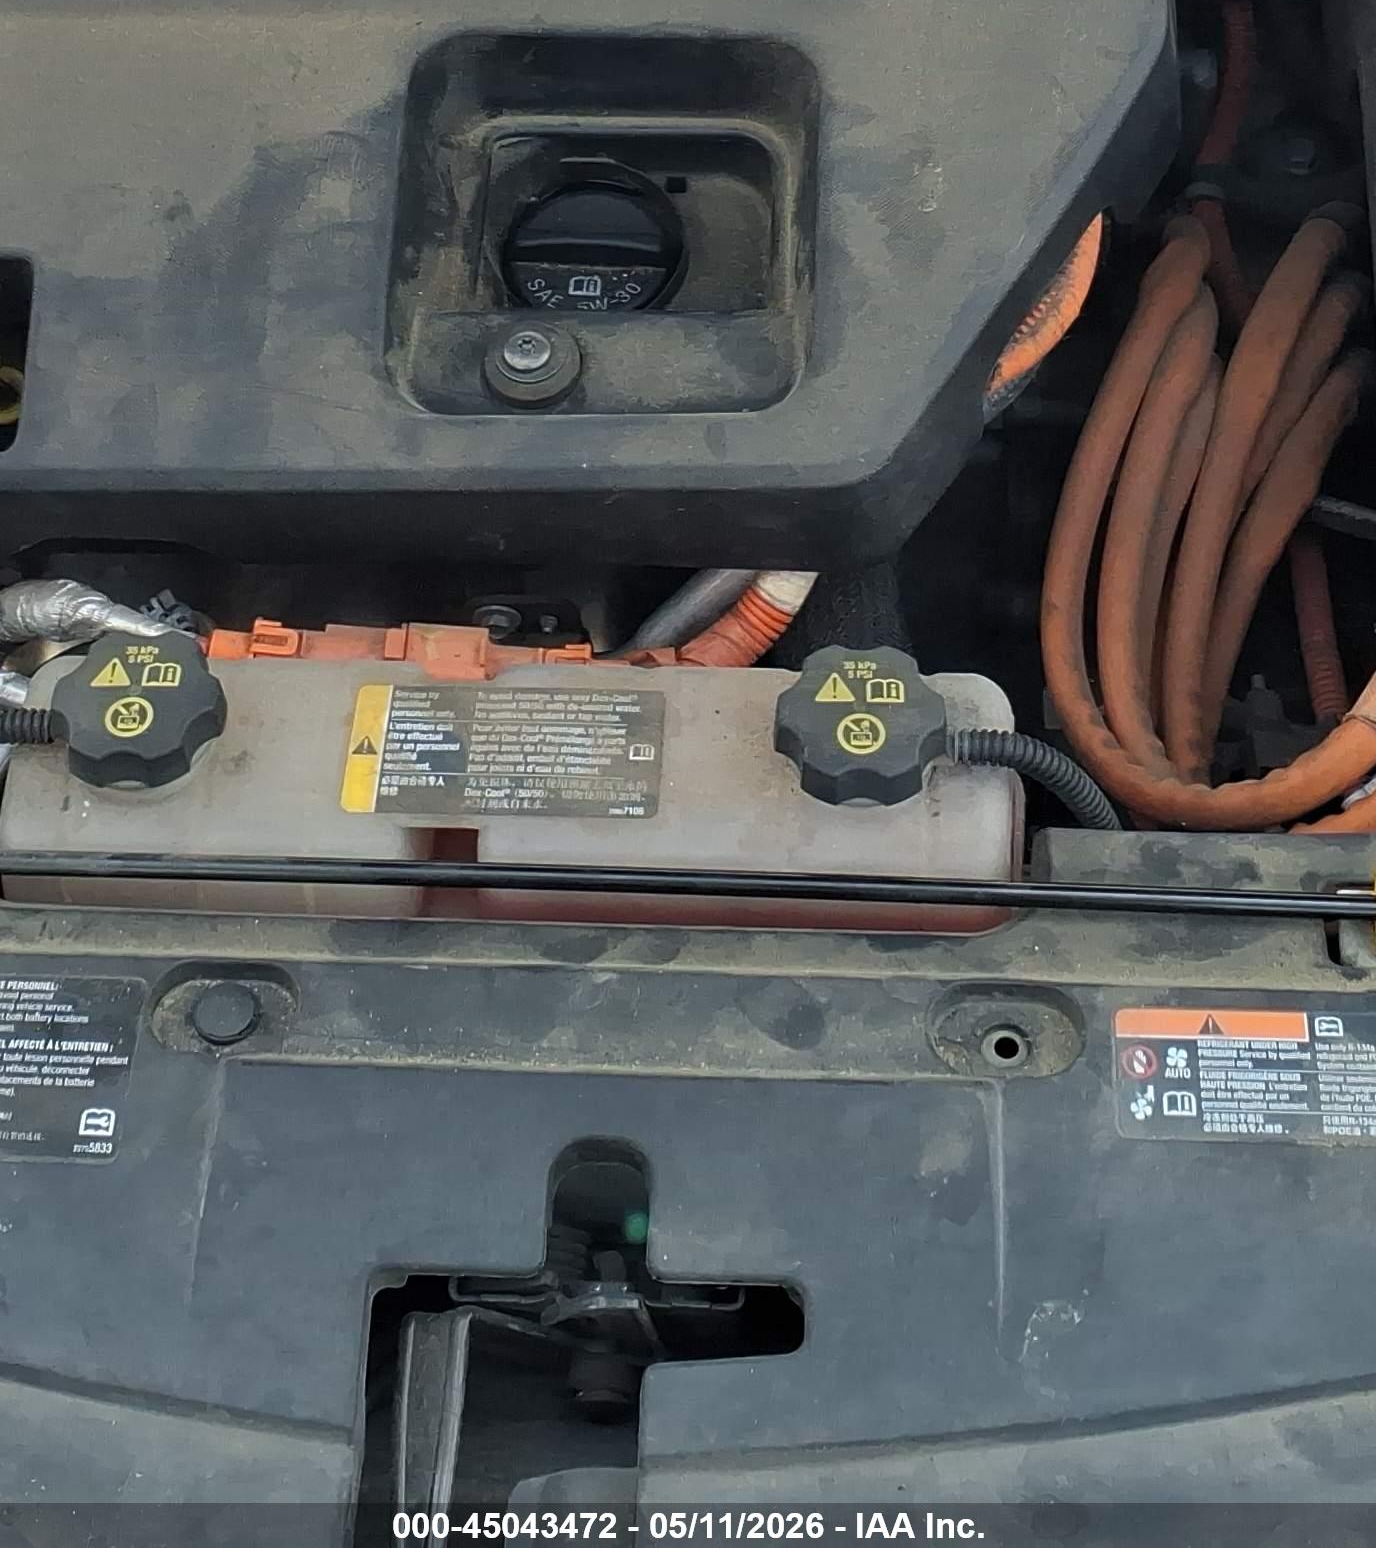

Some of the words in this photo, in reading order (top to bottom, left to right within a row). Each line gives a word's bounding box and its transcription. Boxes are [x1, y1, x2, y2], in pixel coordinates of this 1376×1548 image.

[528, 279, 564, 308] SAE
[141, 646, 159, 655] kPa
[137, 655, 154, 663] PSI
[843, 661, 855, 669] 35
[858, 661, 877, 670] kPa
[848, 670, 854, 678] 5
[857, 670, 873, 679] PSI
[8, 1038, 44, 1049] AFFECTÉ
[1165, 1067, 1191, 1079] AUTO
